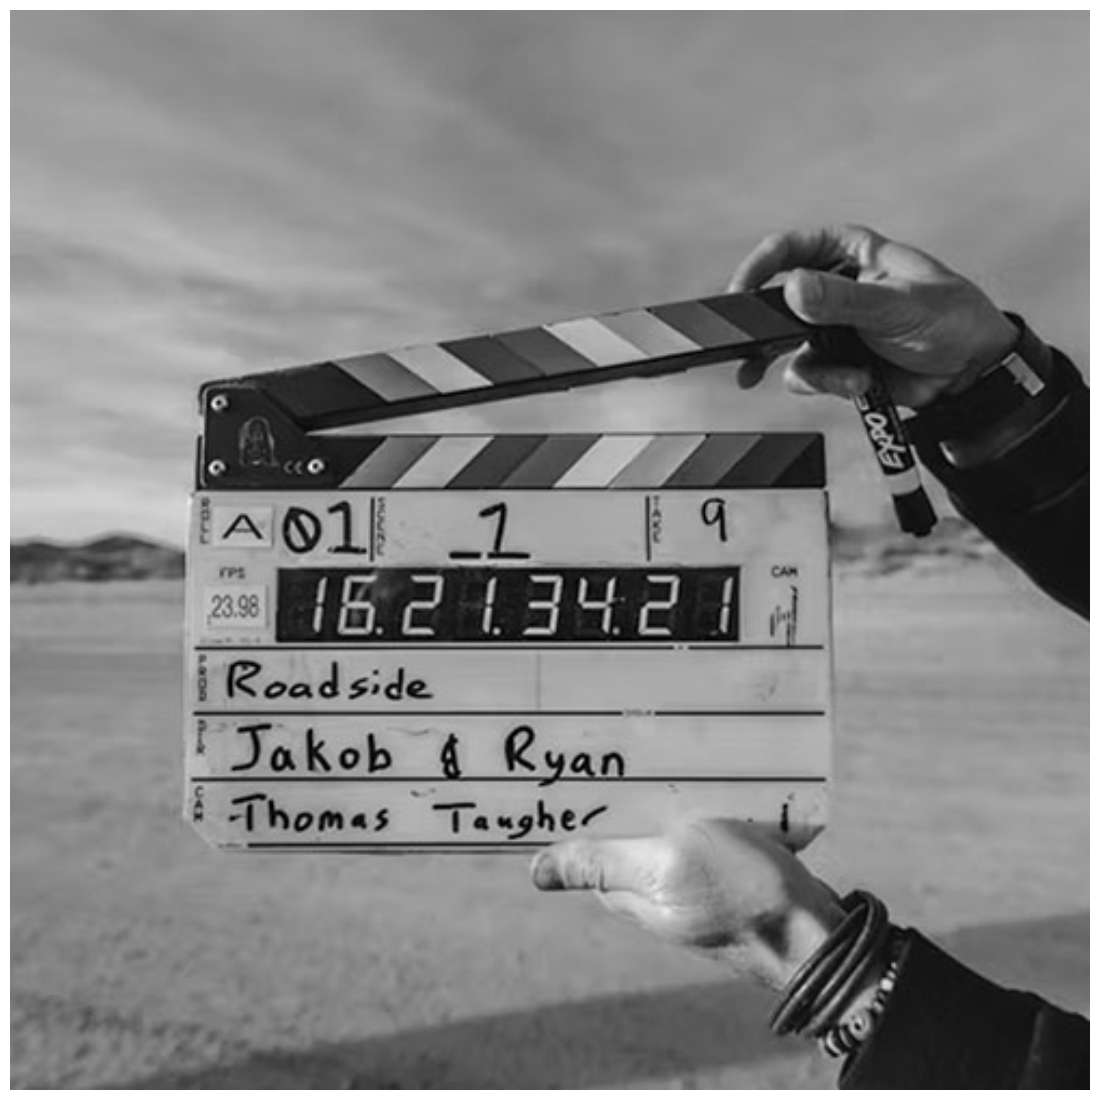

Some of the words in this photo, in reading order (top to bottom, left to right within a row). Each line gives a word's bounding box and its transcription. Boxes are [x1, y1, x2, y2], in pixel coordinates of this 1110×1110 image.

[864, 412, 906, 470] EXPO
[222, 514, 263, 540] A
[282, 501, 367, 555] 01
[701, 498, 727, 542] 9
[771, 564, 798, 578] CAM
[211, 594, 259, 618] 23.98
[227, 660, 433, 700] Roadside
[231, 723, 392, 774] Jakob
[504, 725, 625, 786] Ryan
[230, 793, 389, 832] Thomas
[432, 800, 608, 840] Taugher
